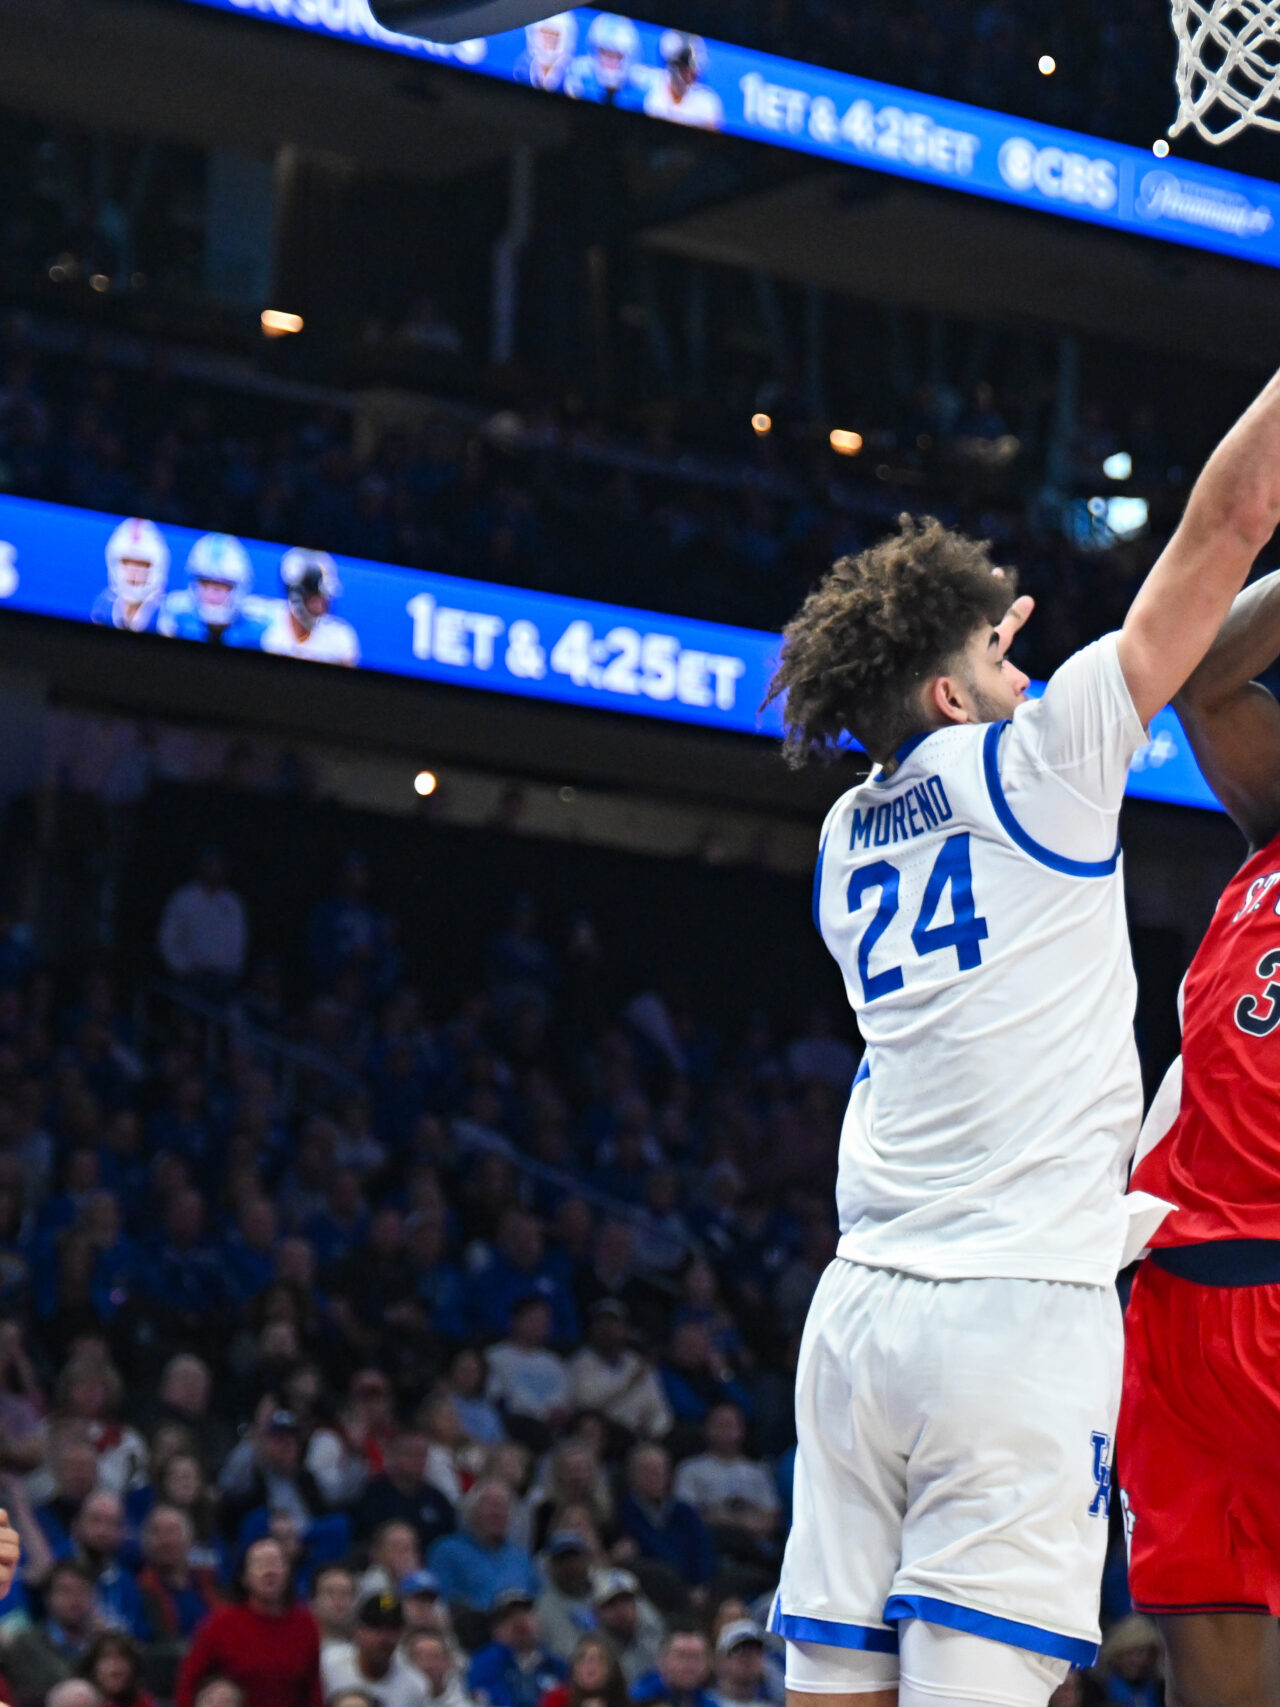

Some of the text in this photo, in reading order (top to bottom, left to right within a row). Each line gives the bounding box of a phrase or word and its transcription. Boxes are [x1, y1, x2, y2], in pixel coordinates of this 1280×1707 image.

[808, 95, 841, 143] &
[1032, 146, 1118, 211] CBS
[505, 619, 546, 680] &
[849, 774, 953, 851] MORENO
[847, 831, 989, 1004] 24
